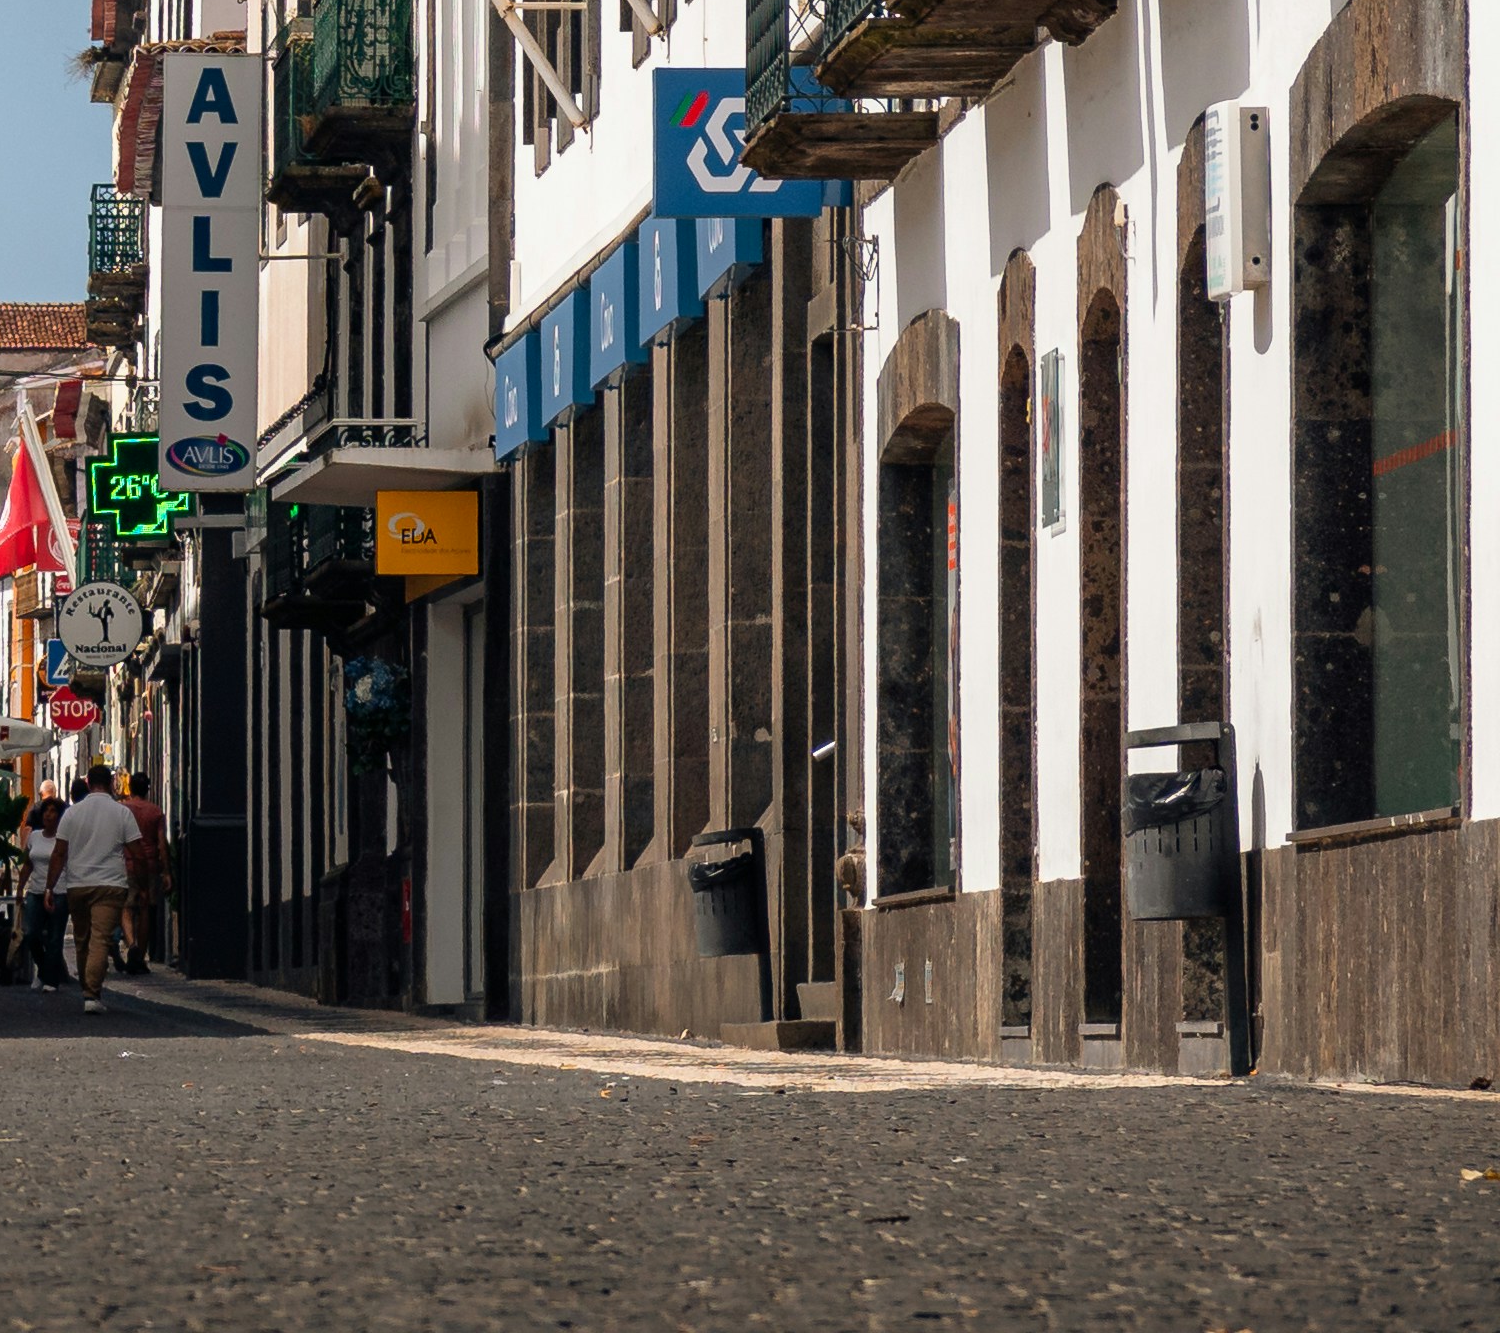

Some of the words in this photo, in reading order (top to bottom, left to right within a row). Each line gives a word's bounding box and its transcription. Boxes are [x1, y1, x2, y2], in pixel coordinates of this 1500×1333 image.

[182, 67, 239, 422] AVLIS
[182, 445, 234, 464] AVLIS
[401, 528, 438, 545] EDA
[65, 588, 136, 617] Restaurante
[75, 643, 127, 653] Nacional
[51, 700, 94, 717] STOP
